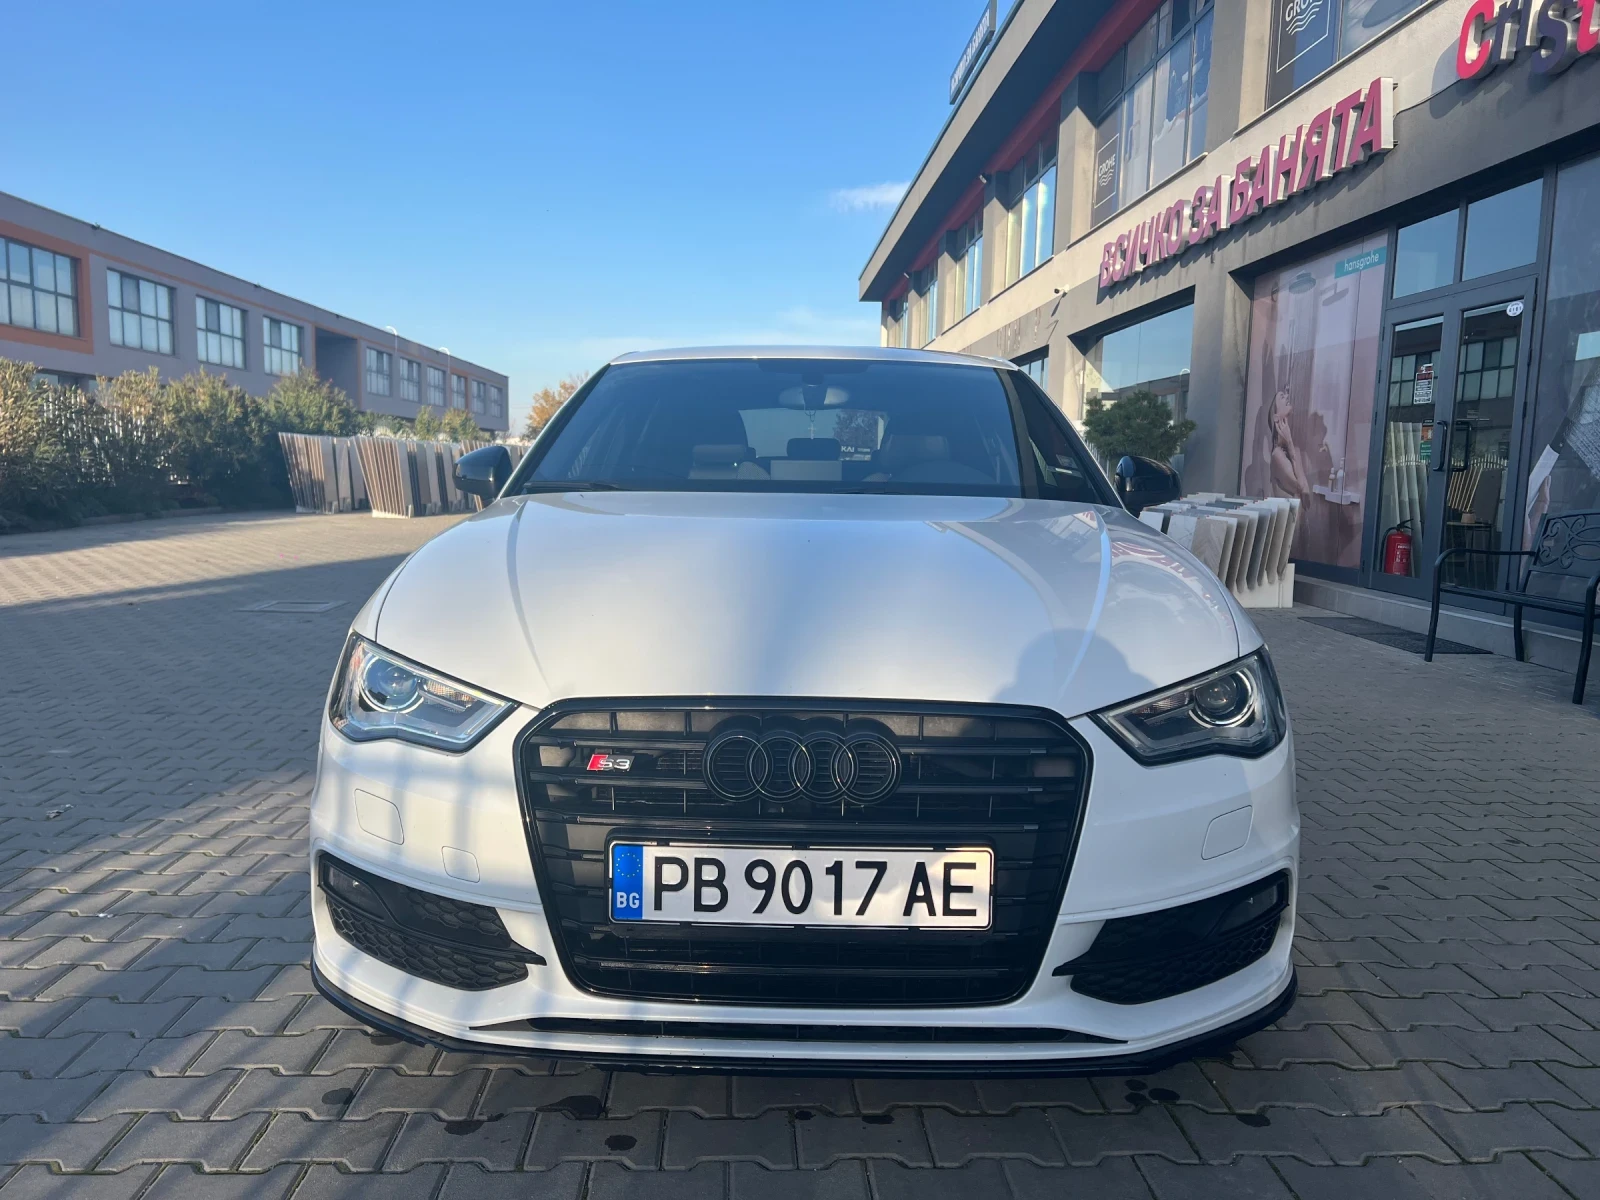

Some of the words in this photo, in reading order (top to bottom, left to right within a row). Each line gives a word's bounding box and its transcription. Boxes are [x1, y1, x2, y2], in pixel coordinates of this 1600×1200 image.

[1098, 153, 1116, 177] GROHE
[1100, 199, 1188, 288] ВСИЧКО
[1189, 175, 1225, 245] ЗА
[1230, 77, 1387, 225] БАНЯТА
[1343, 250, 1380, 273] hansgrohe
[597, 758, 631, 770] S3
[653, 856, 729, 913] PB
[744, 859, 888, 916] 9017
[902, 861, 977, 917] AE
[616, 892, 641, 909] BG
